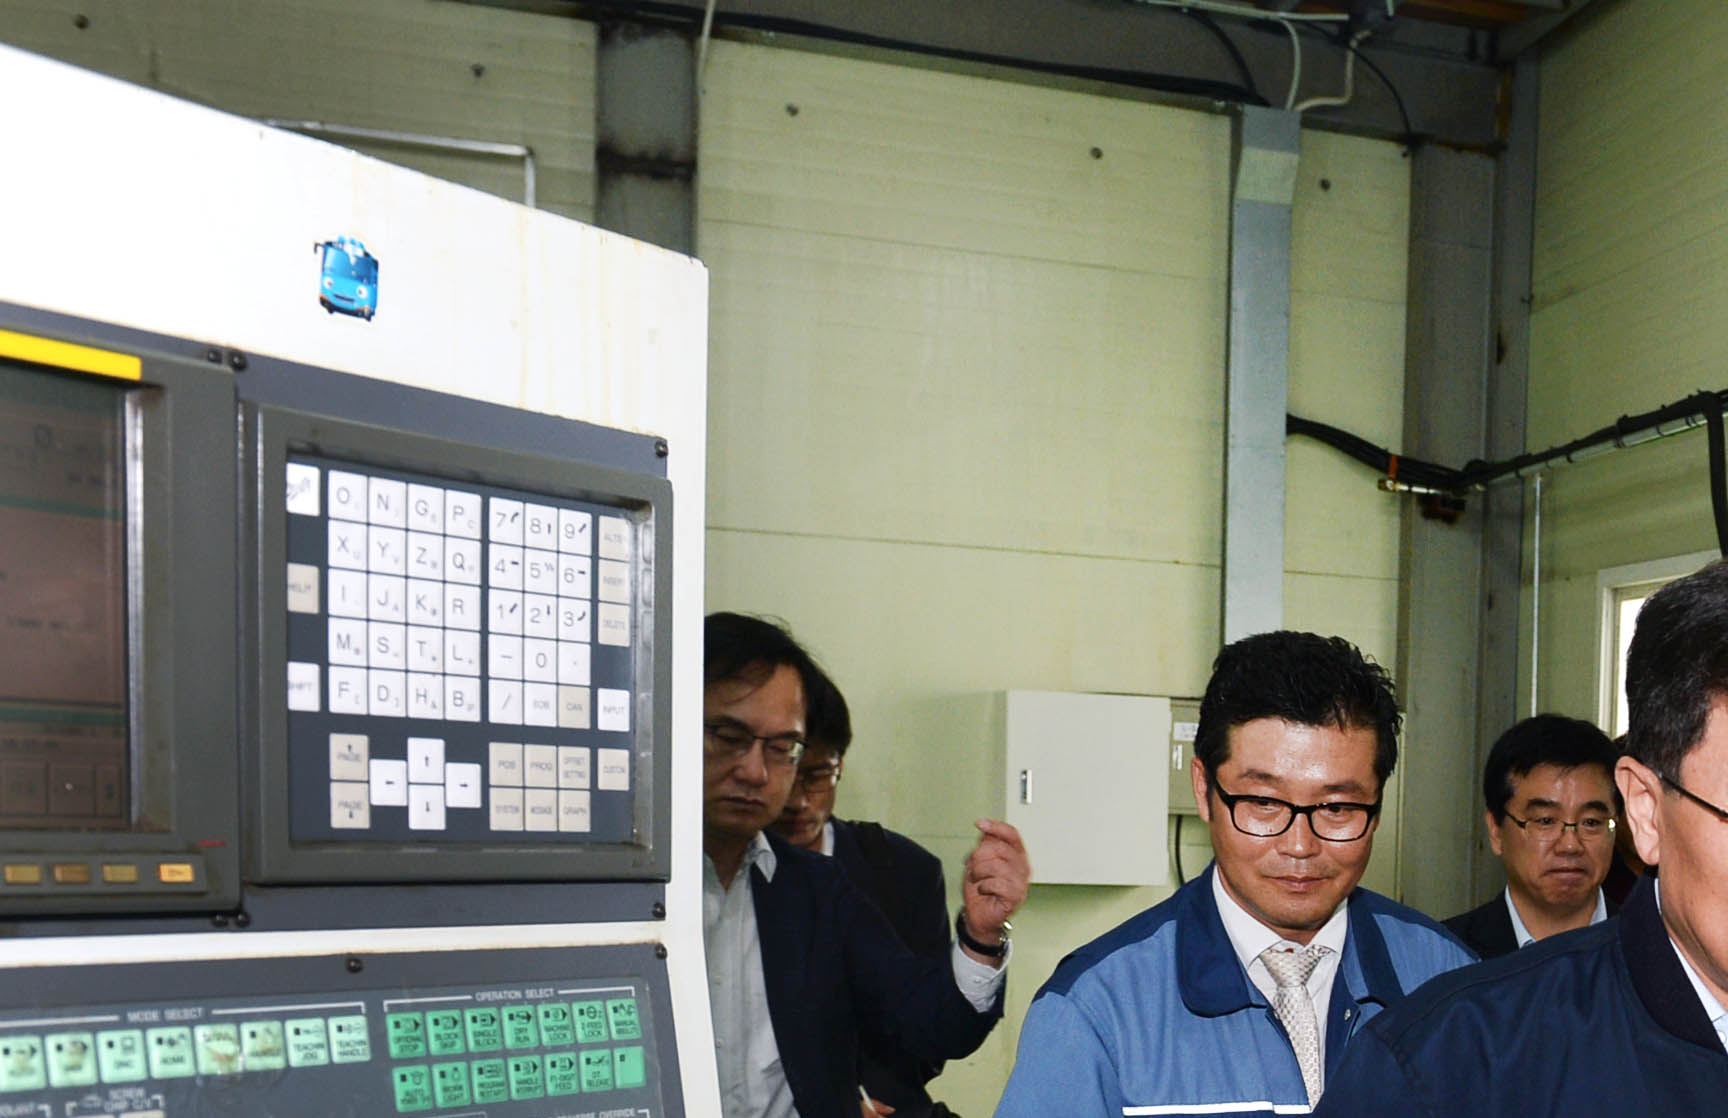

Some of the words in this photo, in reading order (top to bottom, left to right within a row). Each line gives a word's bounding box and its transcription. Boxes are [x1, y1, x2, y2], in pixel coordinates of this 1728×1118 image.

[336, 486, 350, 504] O
[377, 493, 389, 511] N
[415, 500, 429, 516] G
[452, 505, 464, 521] P
[496, 511, 506, 527] 7
[530, 518, 541, 534] 8
[564, 523, 575, 539] 9
[337, 535, 349, 553] X
[377, 541, 389, 557] Y
[415, 547, 427, 565] Z
[452, 552, 465, 571] Q
[495, 559, 505, 573] 4
[530, 563, 540, 579] 5
[564, 567, 575, 584] 6
[377, 591, 389, 607] J
[415, 594, 427, 611] K
[453, 599, 464, 615] R
[498, 604, 503, 619] 1
[530, 607, 540, 623] 2
[563, 611, 574, 627] 3
[336, 633, 351, 649] M
[377, 637, 389, 654] S
[416, 640, 426, 657] T
[452, 644, 463, 661] L
[338, 681, 349, 698] F
[377, 685, 389, 702] D
[416, 688, 427, 704] H
[453, 691, 464, 708] B
[475, 990, 523, 1002] OPERATION
[525, 988, 554, 998] SELECT
[128, 1010, 160, 1022] MODE
[164, 1007, 203, 1021] SELECT
